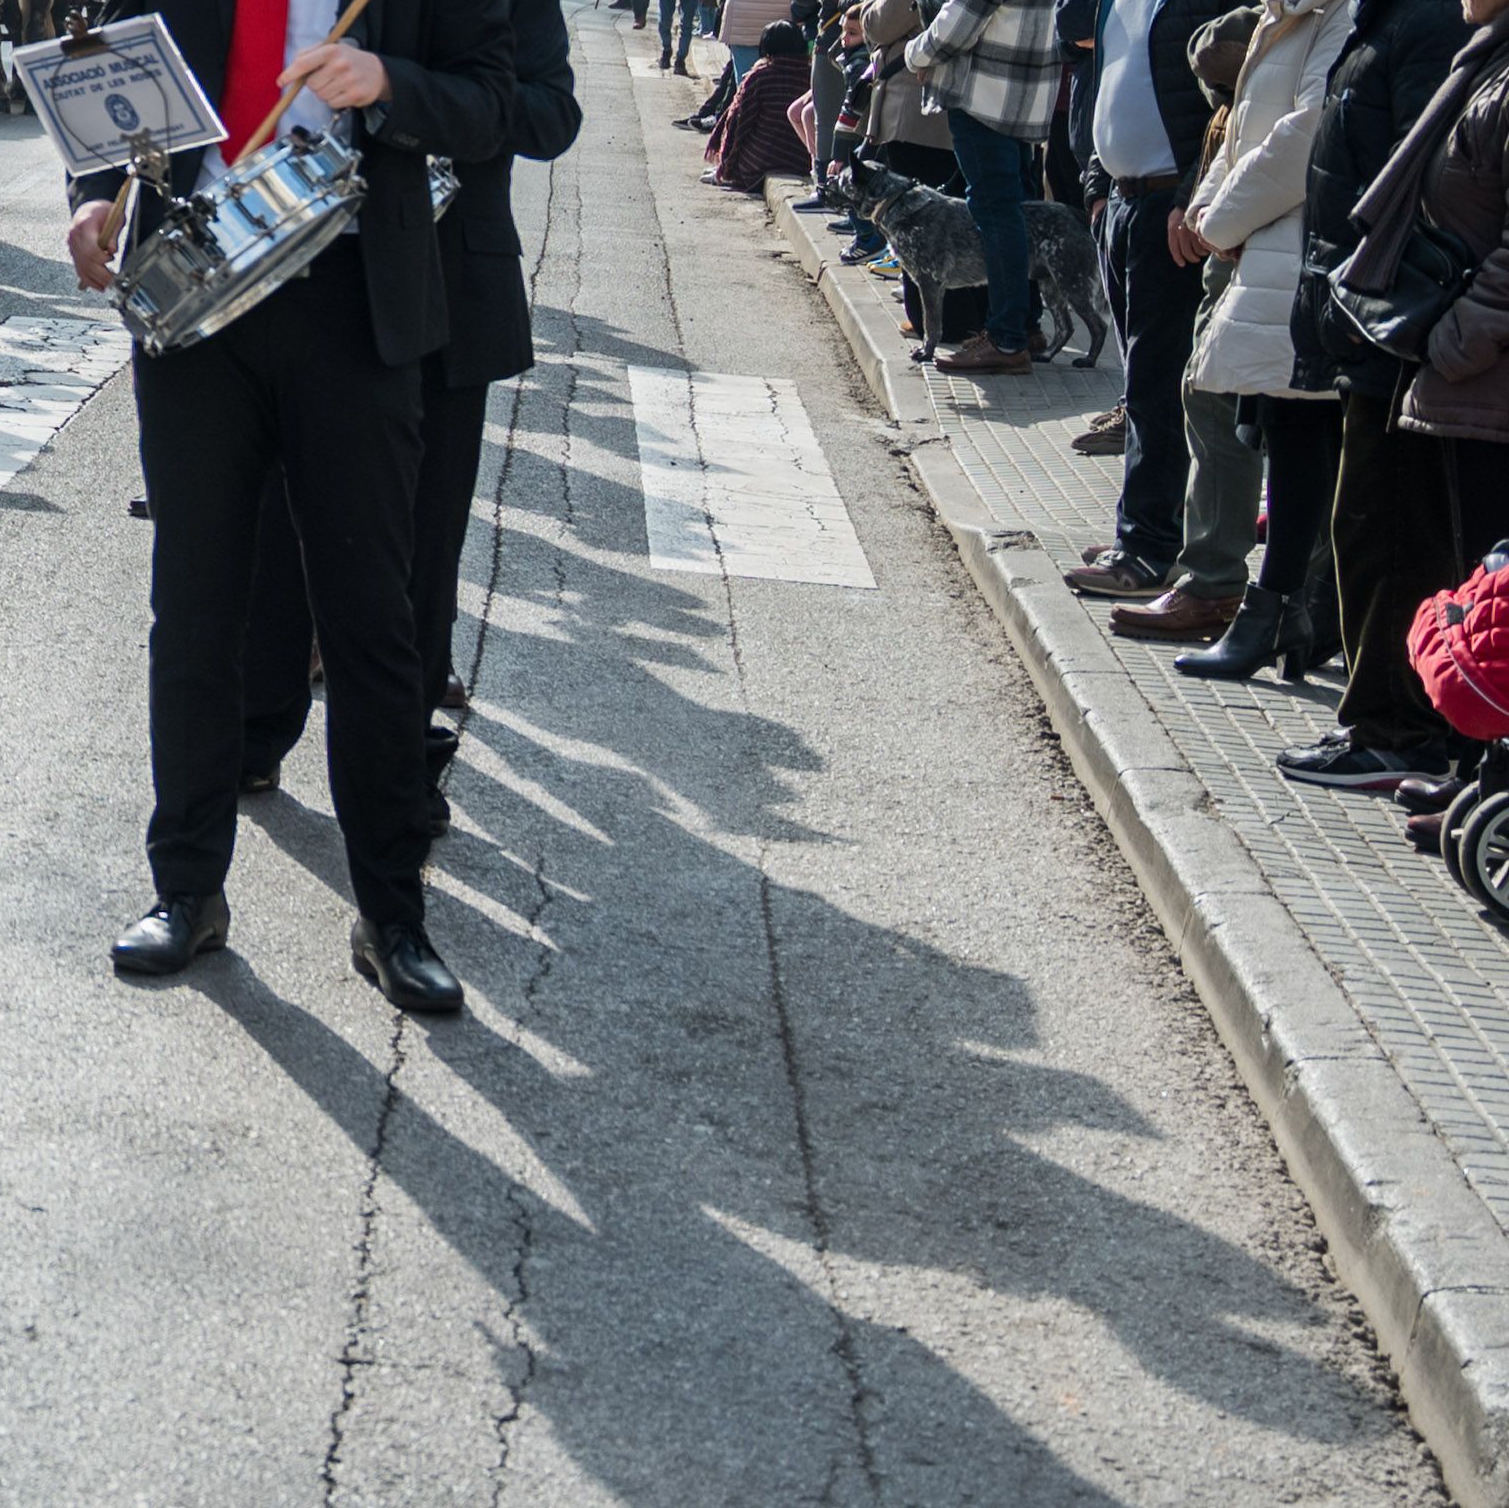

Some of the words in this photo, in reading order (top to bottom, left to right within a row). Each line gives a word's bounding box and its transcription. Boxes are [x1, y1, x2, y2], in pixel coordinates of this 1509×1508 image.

[42, 65, 106, 90] ASSOCIACIÓ
[108, 53, 159, 74] MUSICAL
[90, 82, 104, 93] DE
[108, 78, 126, 89] LES
